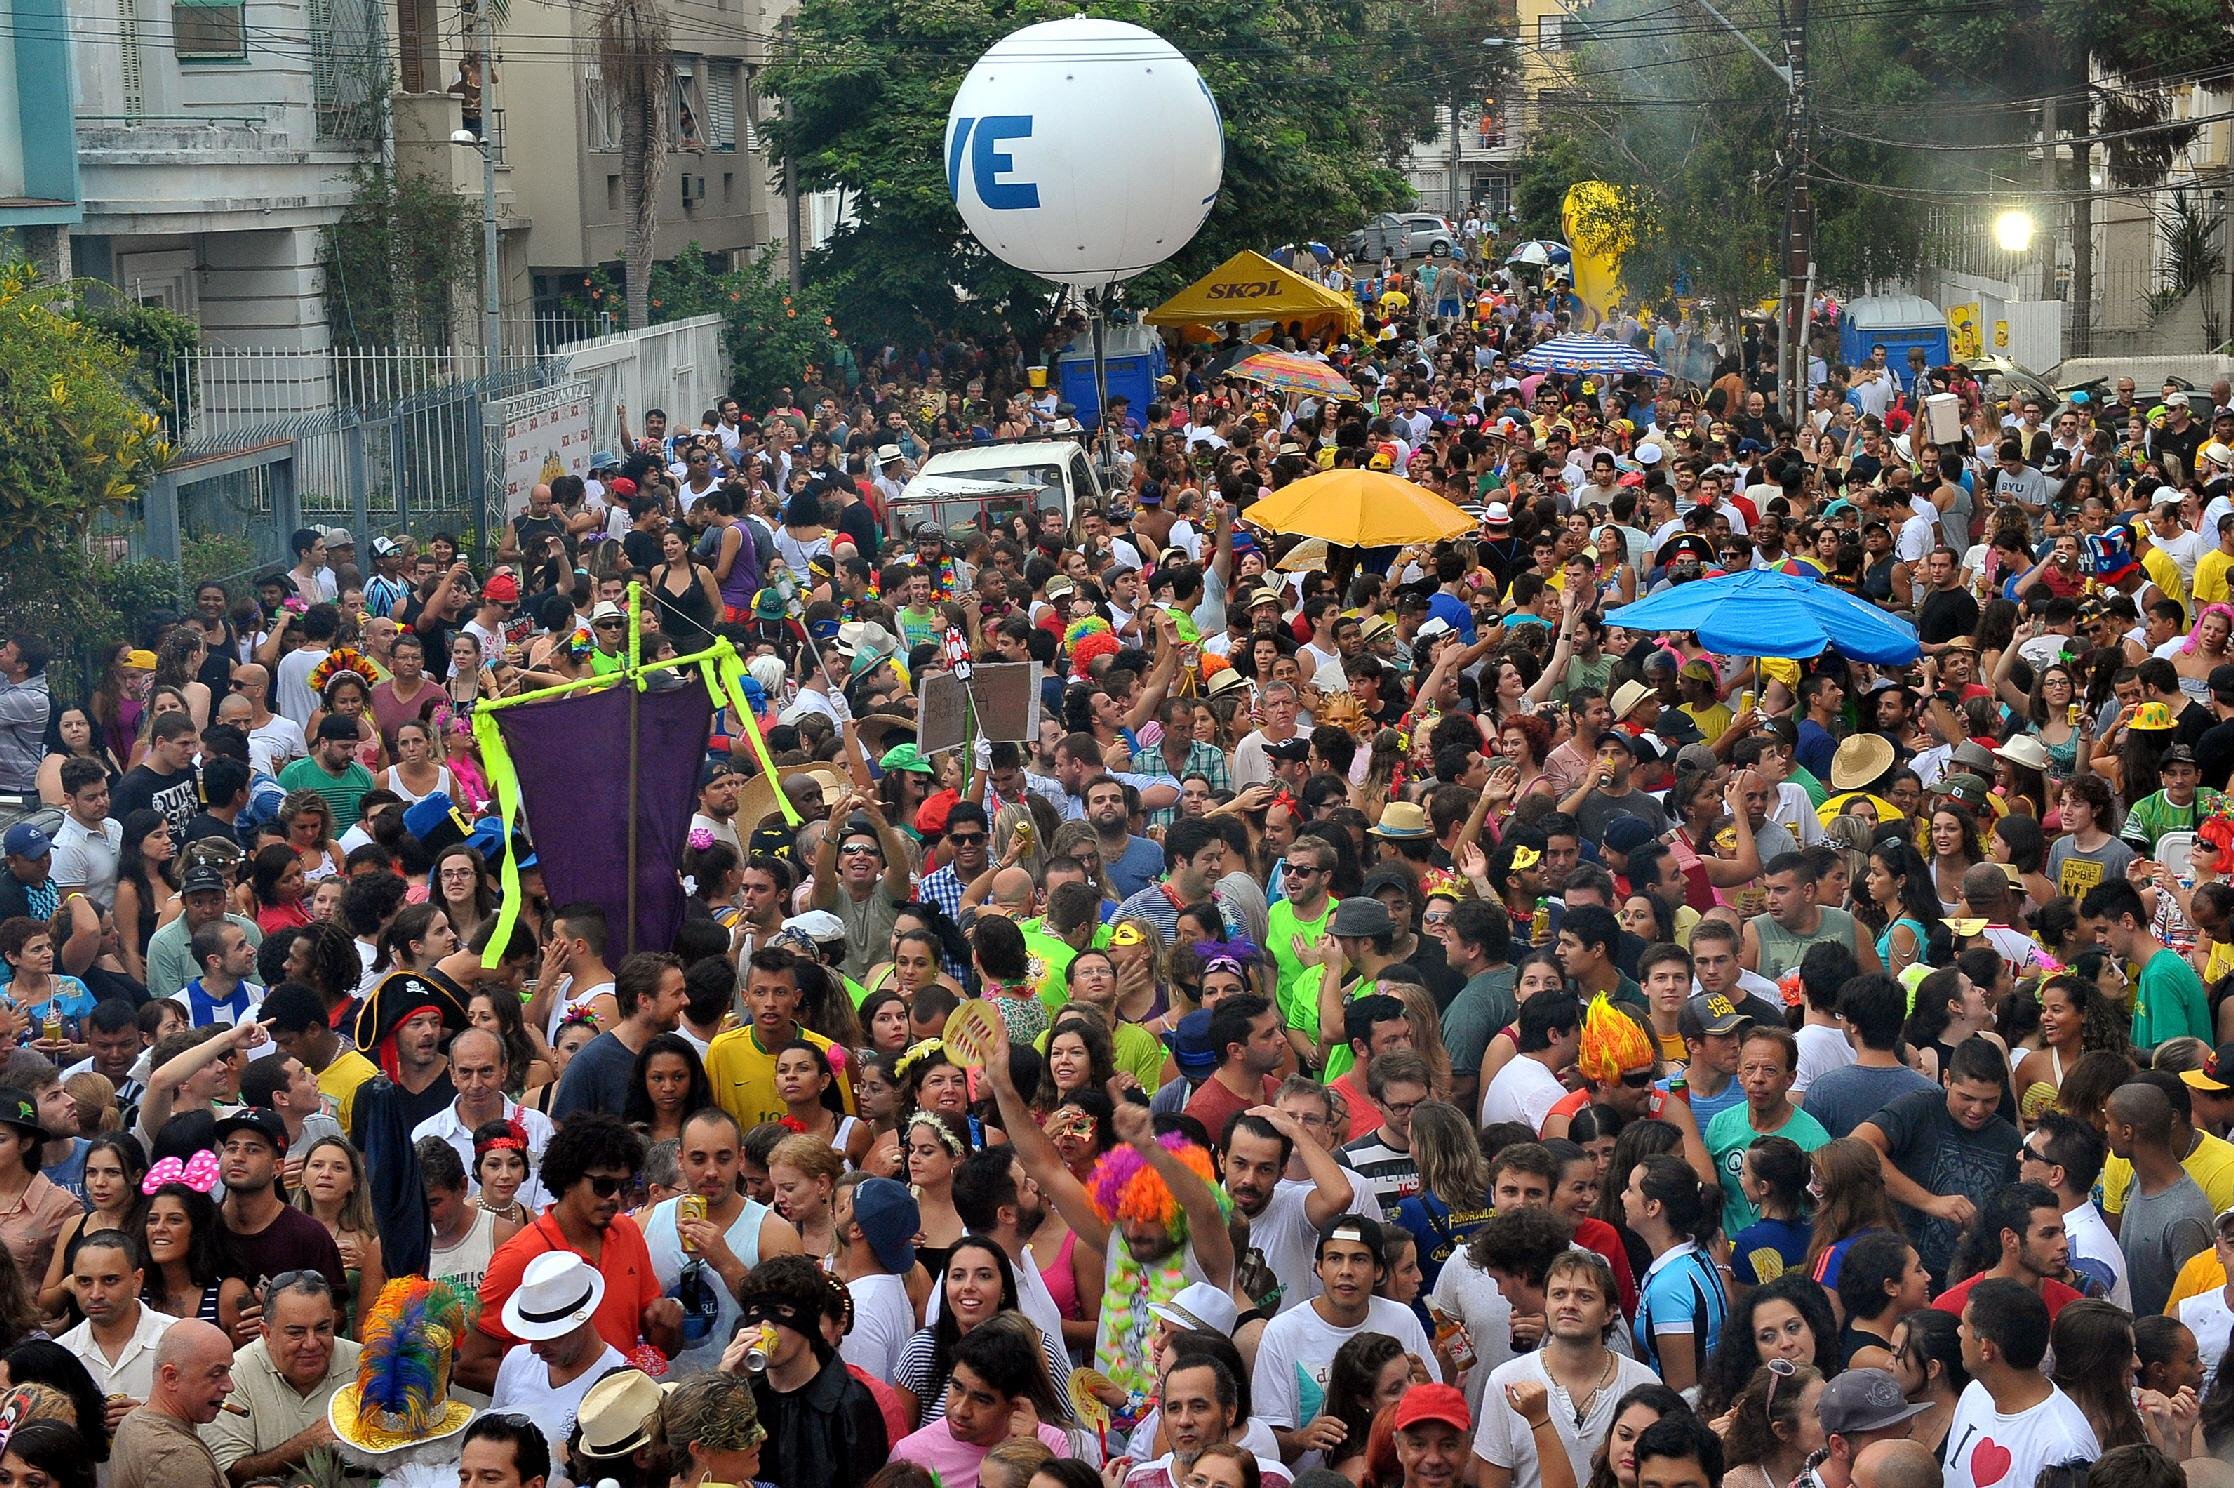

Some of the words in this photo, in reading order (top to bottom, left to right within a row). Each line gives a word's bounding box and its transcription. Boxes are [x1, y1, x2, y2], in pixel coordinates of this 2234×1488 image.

[1206, 280, 1282, 299] SKOL
[2001, 482, 2024, 492] BYU
[2064, 868, 2096, 881] ZOMBIE
[1949, 1423, 1978, 1470] I
